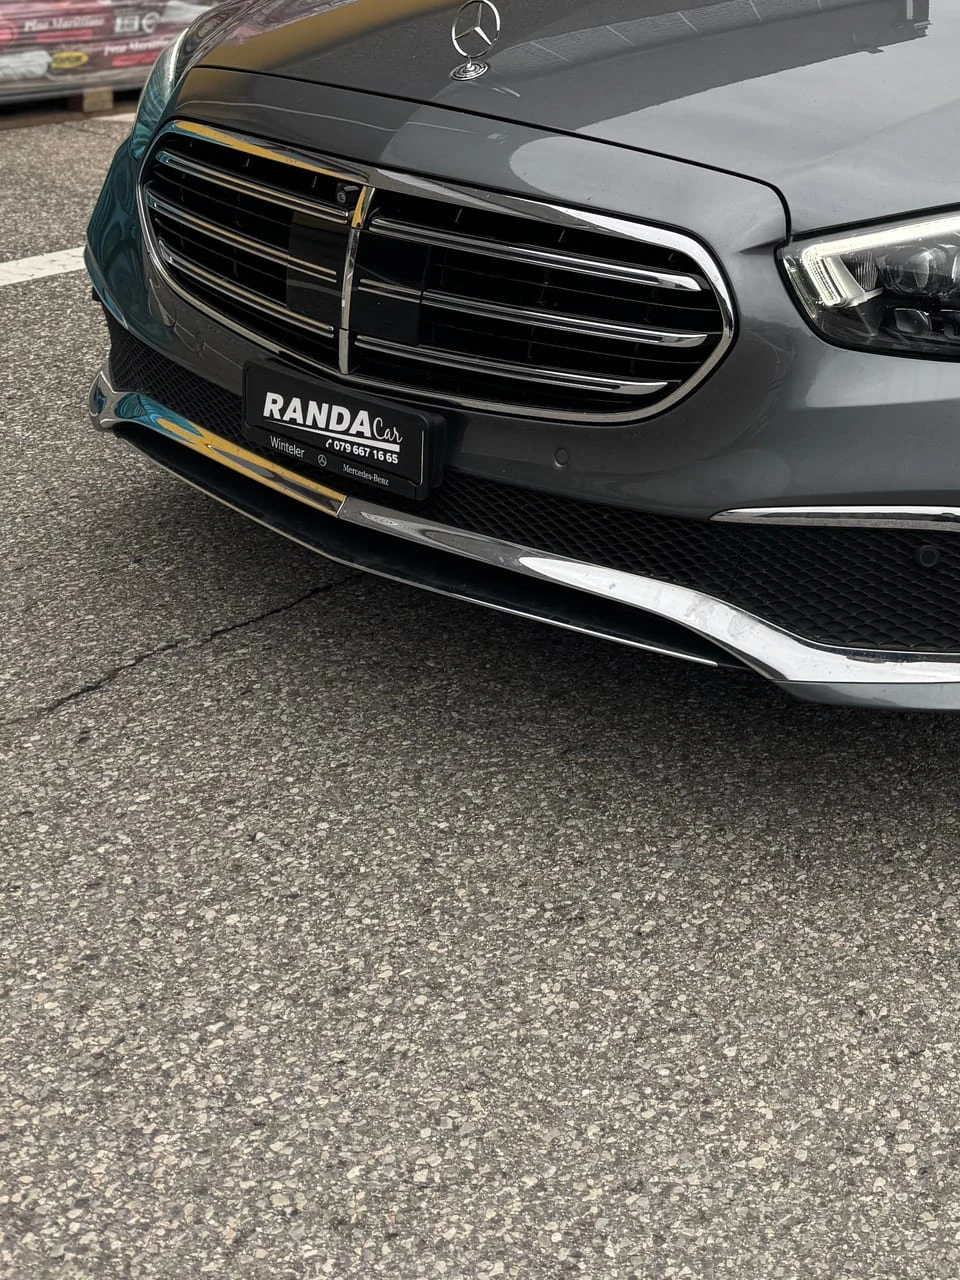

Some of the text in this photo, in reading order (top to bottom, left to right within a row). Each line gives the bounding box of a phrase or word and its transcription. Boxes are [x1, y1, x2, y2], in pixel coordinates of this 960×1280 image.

[263, 392, 403, 443] RANDA Car
[270, 436, 305, 458] Winteler
[334, 440, 399, 464] 079 667 16 65
[342, 463, 389, 486] Mercedes-Benz
